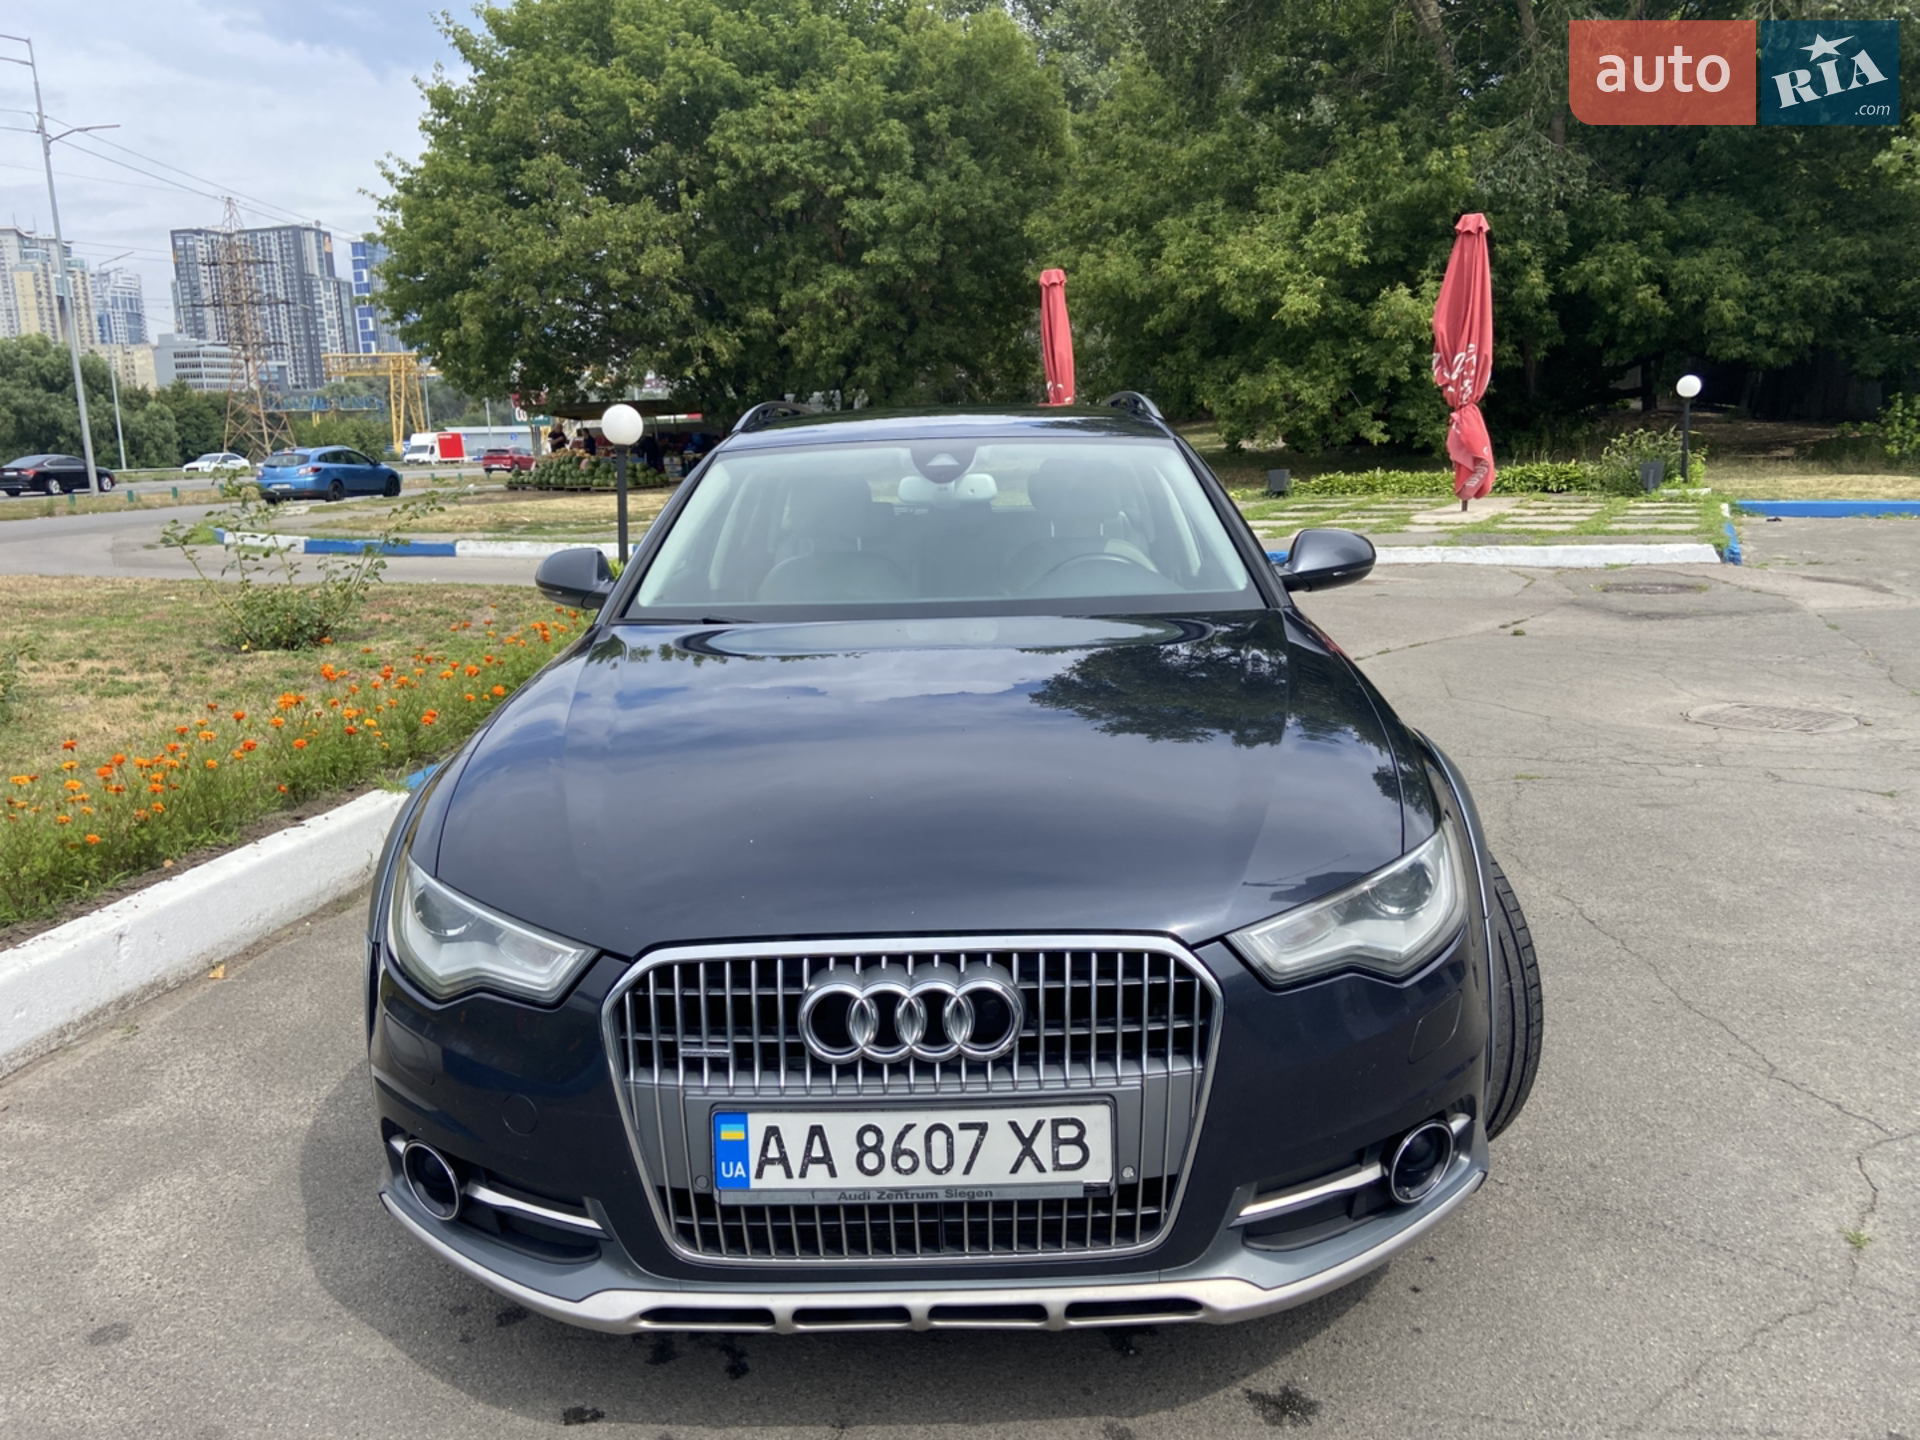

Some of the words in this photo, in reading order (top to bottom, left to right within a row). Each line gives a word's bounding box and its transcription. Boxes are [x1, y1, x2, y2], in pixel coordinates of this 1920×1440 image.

[754, 1123, 838, 1180] AA
[855, 1121, 989, 1177] 8607
[1007, 1116, 1091, 1175] XB
[721, 1160, 746, 1179] UA
[837, 1190, 871, 1201] Audi
[876, 1189, 939, 1201] Zentrum
[944, 1188, 994, 1200] Siegen
